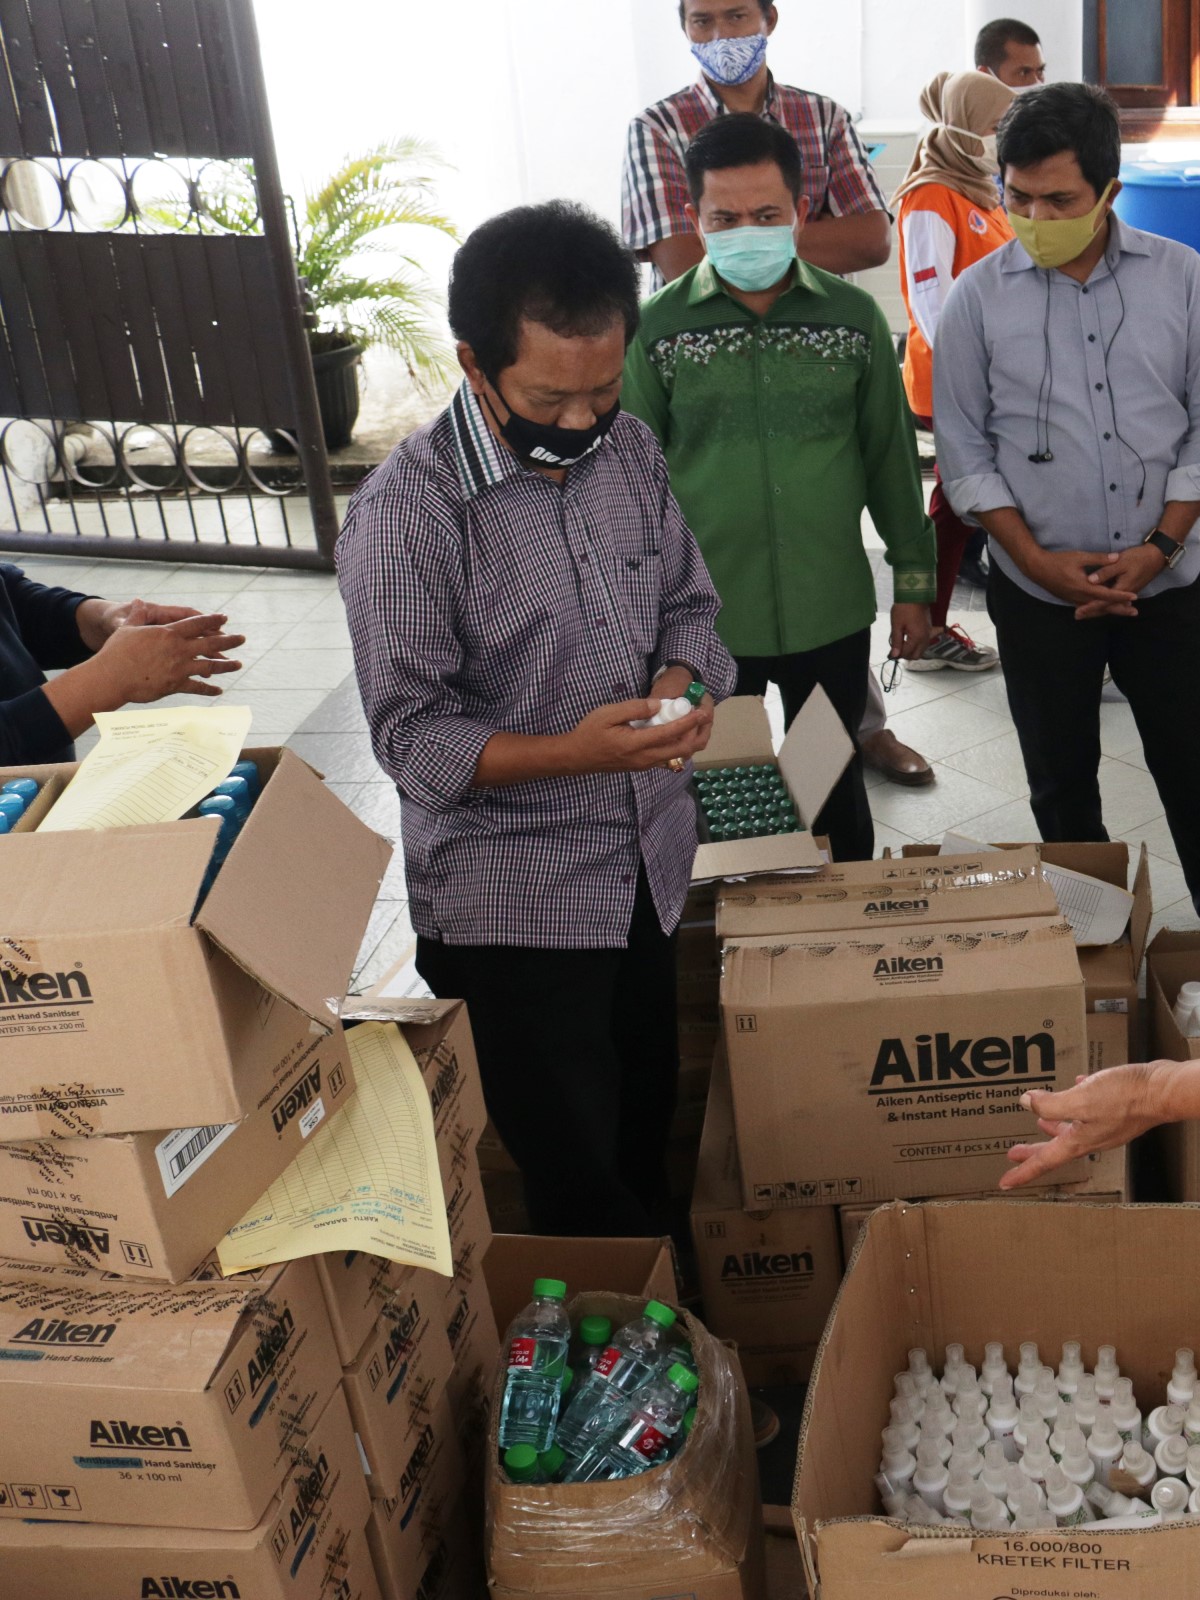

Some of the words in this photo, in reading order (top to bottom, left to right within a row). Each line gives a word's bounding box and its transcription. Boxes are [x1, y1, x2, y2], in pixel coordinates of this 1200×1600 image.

[863, 899, 928, 912] Aiken
[874, 955, 943, 974] Aiken
[0, 966, 92, 1003] ken
[18, 1012, 41, 1020] Hand
[42, 1010, 80, 1018] Sanitiser
[0, 1025, 24, 1034] NTENT
[38, 1025, 51, 1033] pcs
[75, 1021, 85, 1029] ml
[869, 1030, 1056, 1086] Aiken
[272, 1063, 321, 1133] Aiken
[876, 1096, 913, 1108] Aiken
[917, 1091, 983, 1105] Antiseptic
[2, 1103, 33, 1114] MADE
[36, 1102, 47, 1111] IN
[887, 1111, 899, 1122] &
[902, 1109, 947, 1122] Instant
[951, 1106, 985, 1118] Hand
[989, 1103, 1029, 1115] Saniti
[900, 1144, 951, 1158] CONTENT
[955, 1144, 961, 1152] 4
[964, 1142, 982, 1154] pcs
[993, 1141, 1000, 1149] 4
[27, 1187, 39, 1196] ml
[42, 1190, 57, 1199] 100
[70, 1193, 83, 1203] 36
[38, 1201, 60, 1212] Hand
[63, 1206, 118, 1221] Antibacterial
[23, 1220, 110, 1254] Aiken
[7, 1263, 41, 1271] Carton
[42, 1266, 57, 1274] 18
[721, 1251, 814, 1277] Aiken
[61, 1268, 89, 1277] Max:
[14, 1318, 117, 1343] Aiken
[0, 1352, 43, 1361] bacterial
[45, 1354, 73, 1362] Hand
[74, 1355, 114, 1363] Sanitiser
[90, 1420, 190, 1447] Aiken
[79, 1457, 142, 1467] Antibacterial
[145, 1460, 171, 1468] Hand
[174, 1460, 216, 1470] Sanitiser
[119, 1471, 132, 1480] 36
[147, 1472, 166, 1482] 100
[168, 1473, 182, 1482] ml
[1004, 1541, 1102, 1555] 16.000/800
[977, 1553, 1056, 1568] KRETEK
[1063, 1557, 1131, 1571] FILTER
[141, 1575, 241, 1600] Aiken
[1011, 1587, 1070, 1598] Diproduksi
[1073, 1589, 1100, 1599] oleh:
